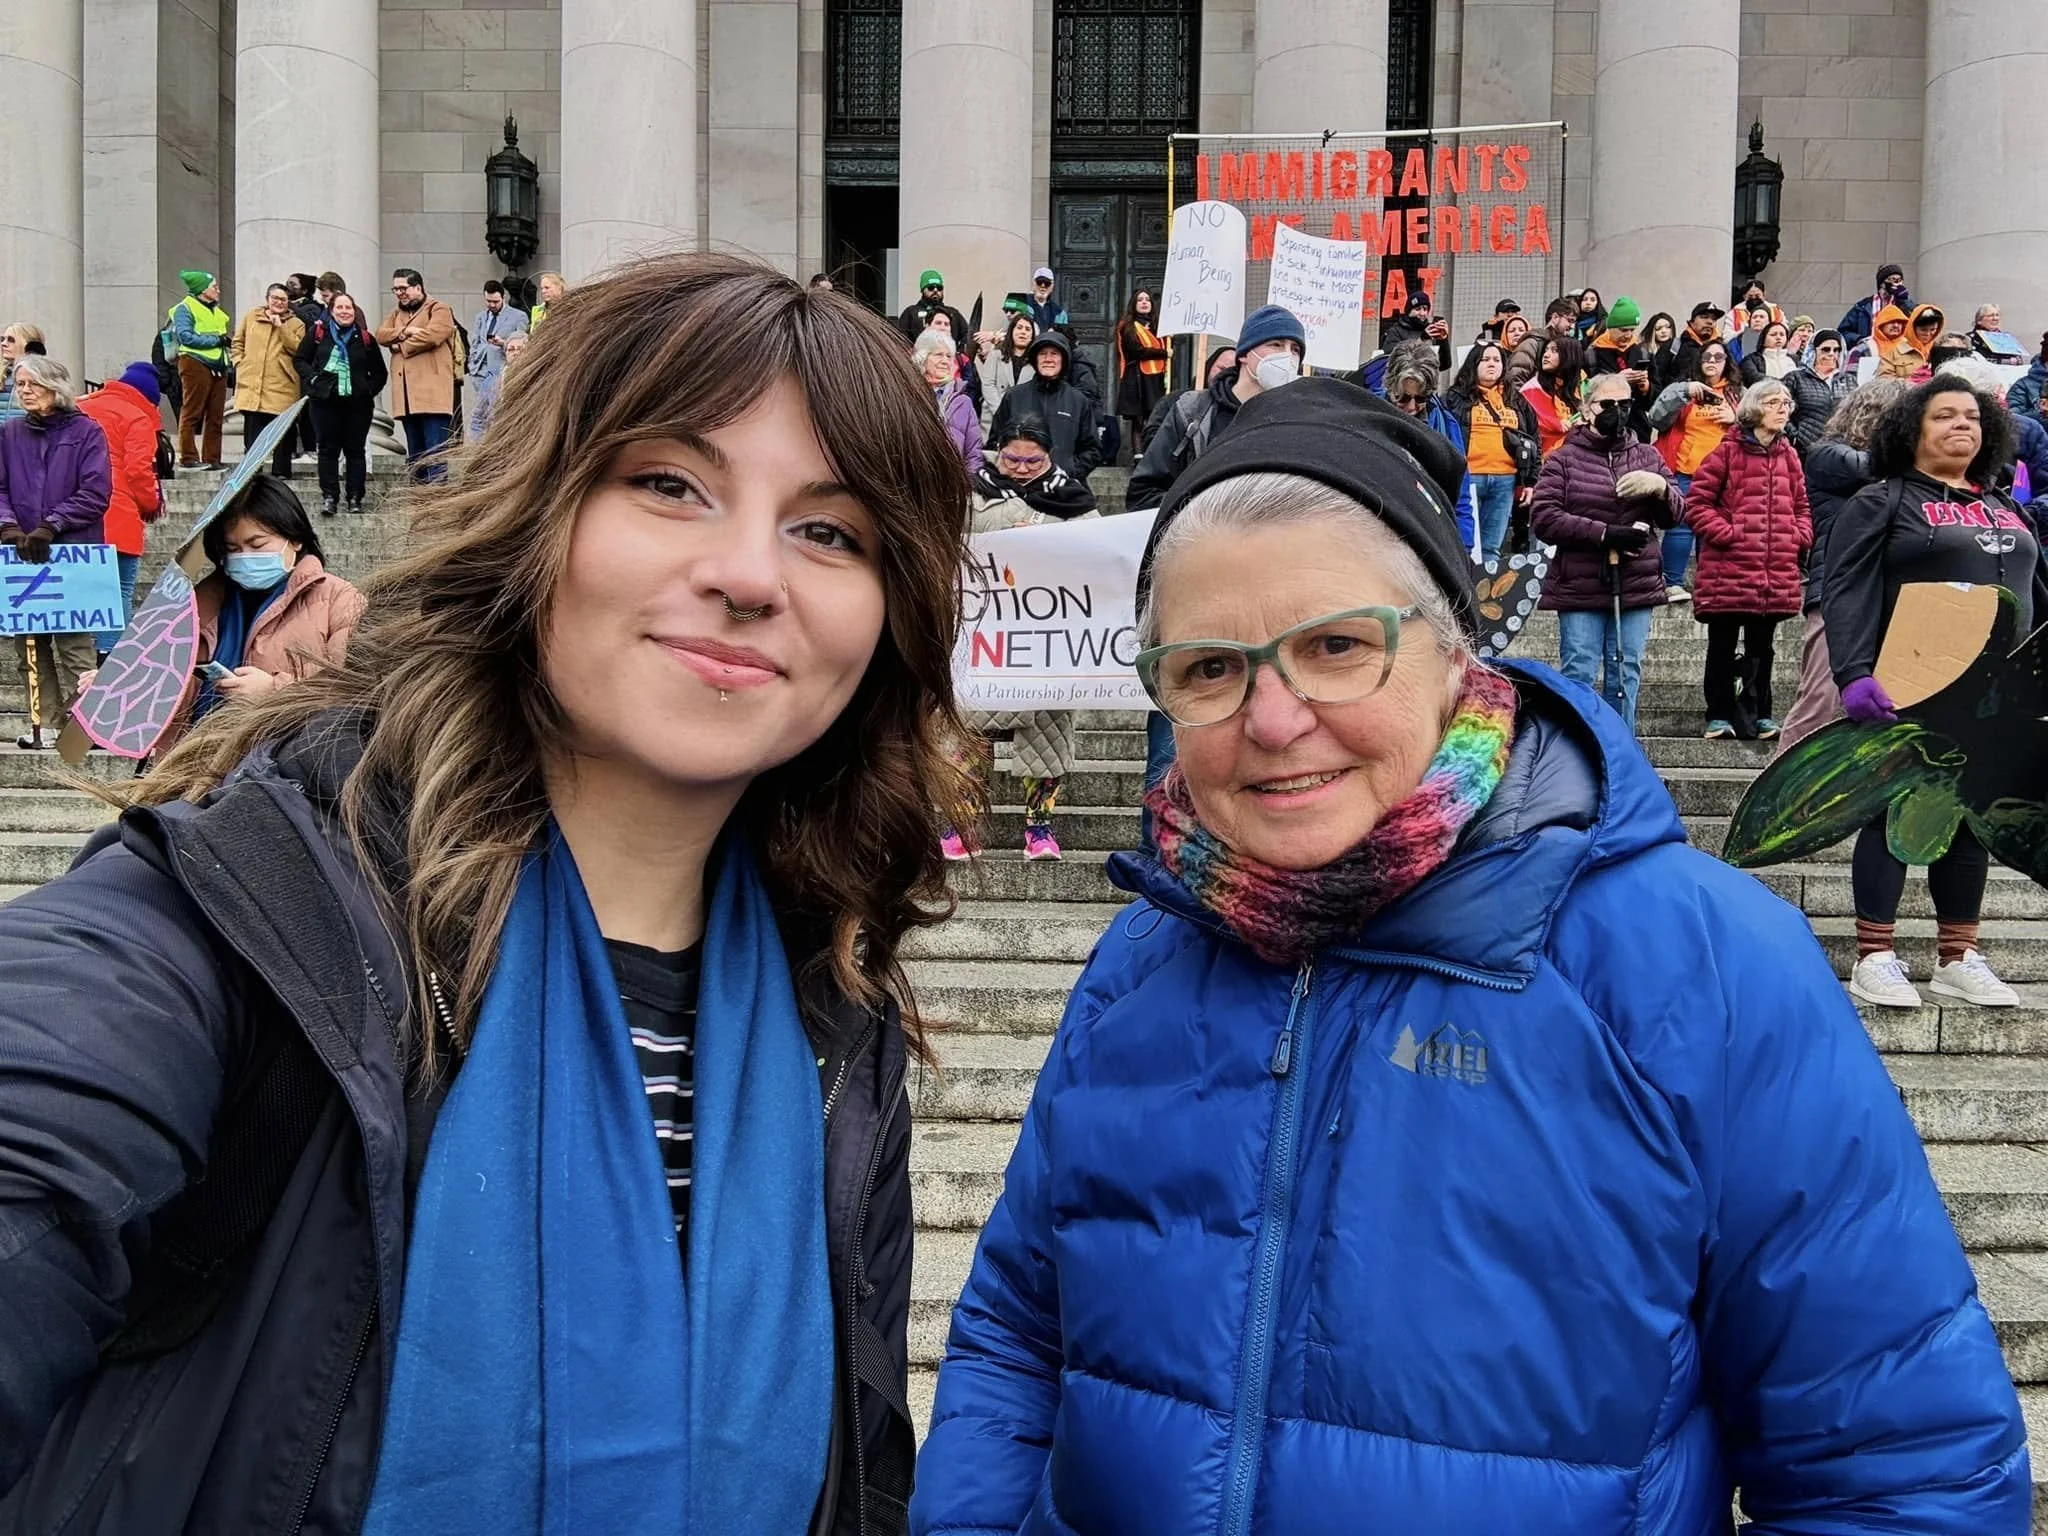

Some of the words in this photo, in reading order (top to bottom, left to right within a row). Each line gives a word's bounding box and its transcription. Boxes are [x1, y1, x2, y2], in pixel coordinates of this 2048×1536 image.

[1197, 144, 1530, 201] IMMIGRANTS
[1189, 203, 1226, 228] NO
[1330, 204, 1552, 257] AMERICA
[1170, 242, 1205, 262] Human
[1199, 260, 1232, 292] Being
[1362, 267, 1441, 321] EAT
[0, 607, 123, 632] IMINAL
[962, 584, 1092, 622] CTION
[970, 626, 1137, 668] NETWO
[970, 683, 981, 698] A
[987, 682, 1065, 701] Partnership
[1068, 683, 1088, 701] for
[1094, 683, 1113, 698] the
[1118, 683, 1148, 698] Com
